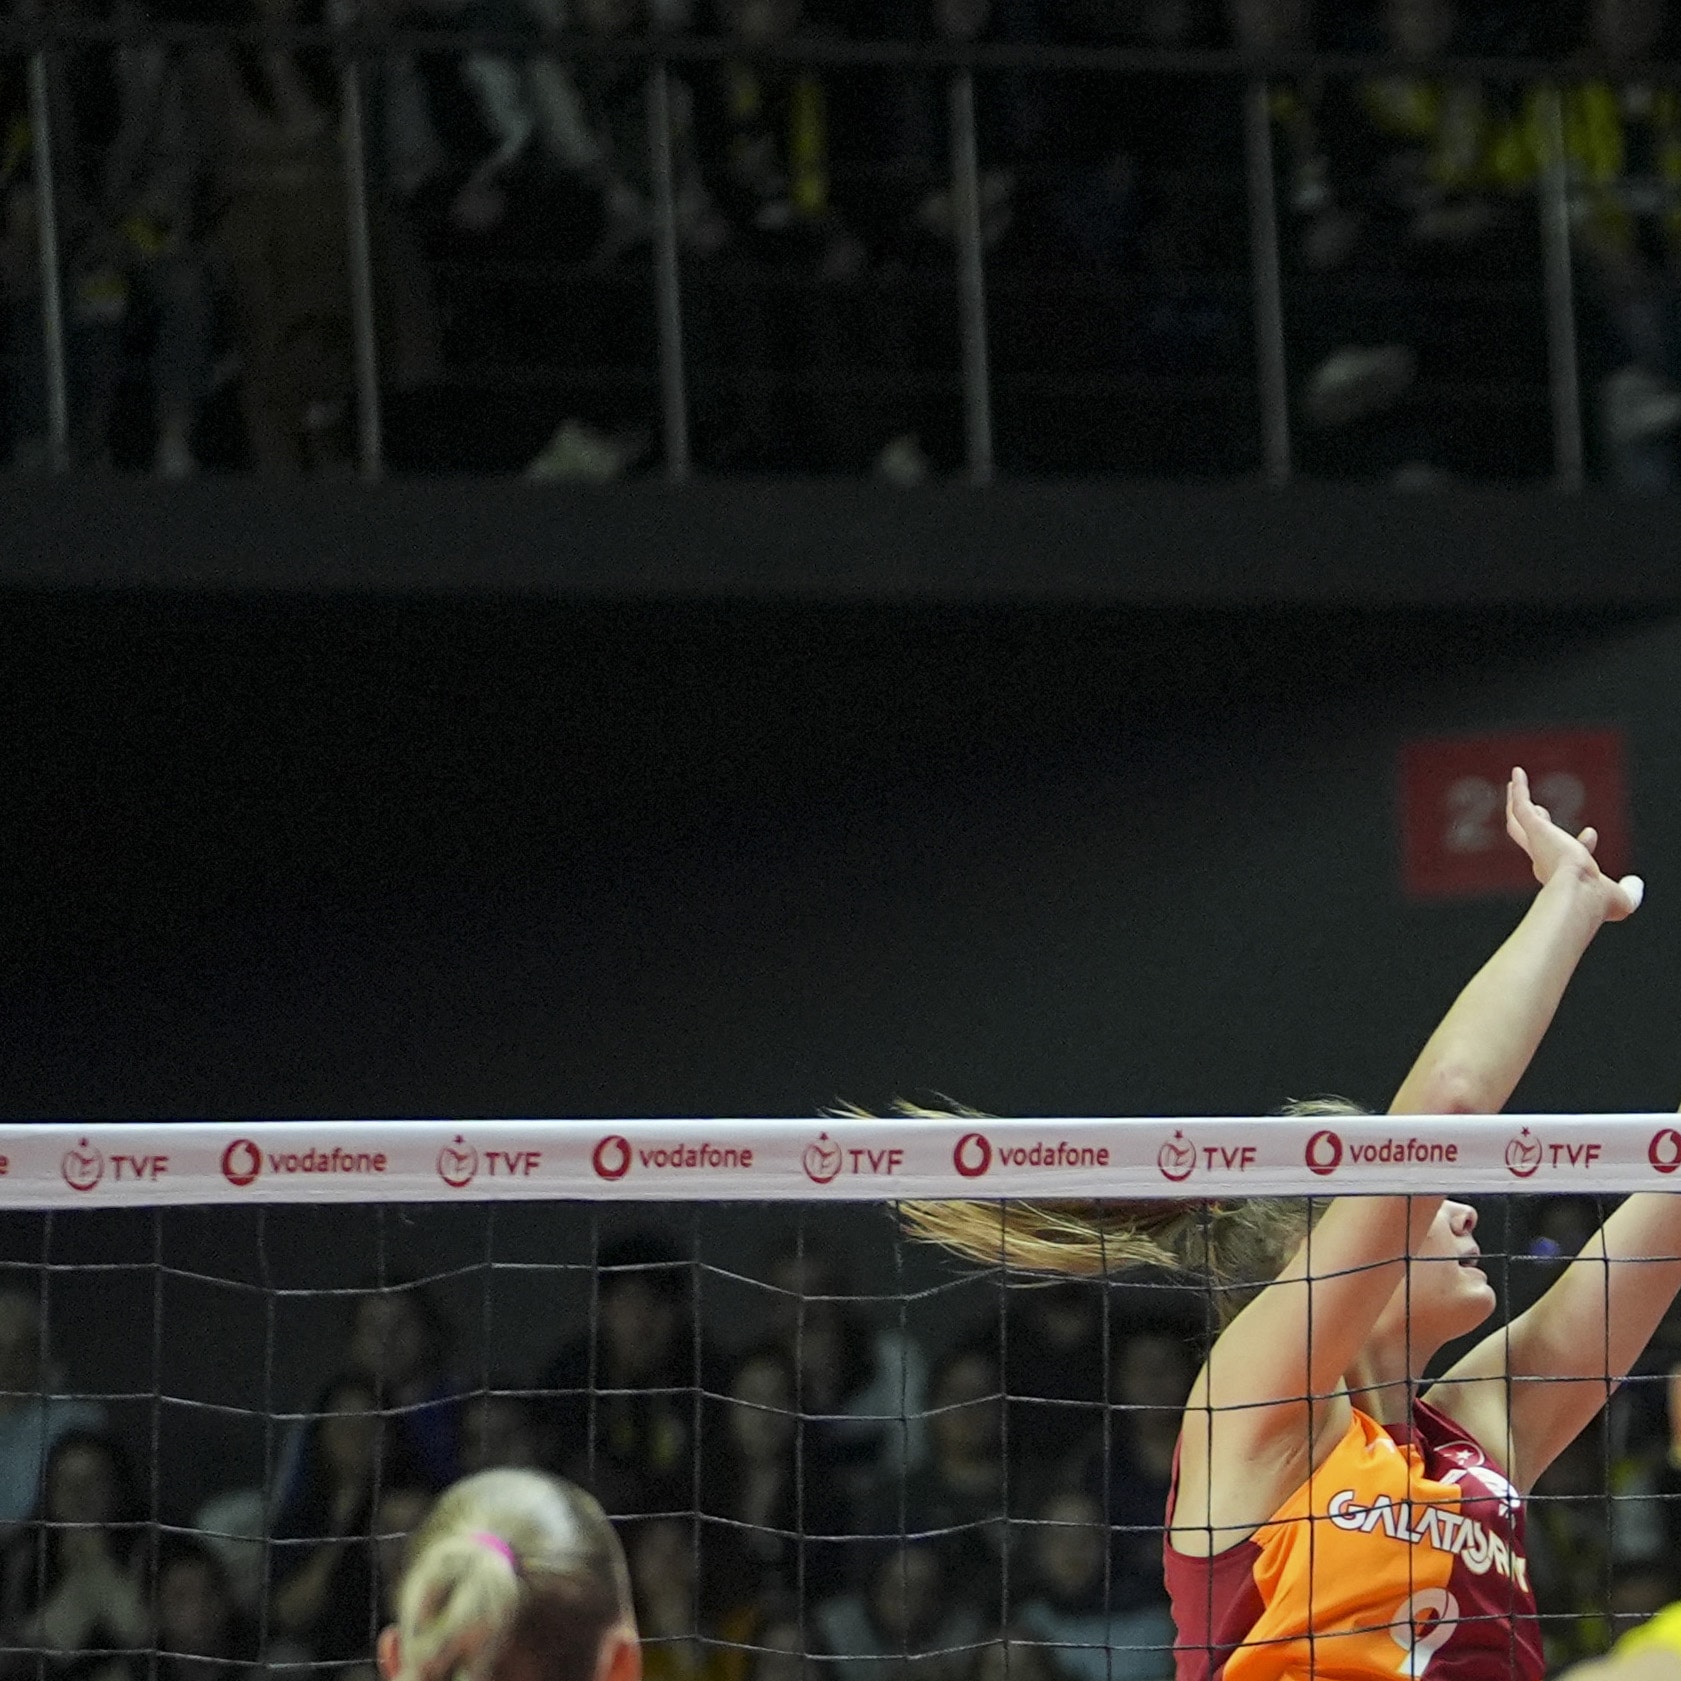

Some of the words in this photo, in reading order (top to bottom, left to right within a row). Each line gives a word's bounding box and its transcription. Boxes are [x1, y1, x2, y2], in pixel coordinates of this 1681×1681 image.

[110, 1153, 169, 1181] TVF
[269, 1144, 388, 1174] vodafone
[485, 1149, 541, 1177] TVF
[638, 1141, 754, 1170] vodafone
[849, 1148, 904, 1176] TVF
[1000, 1141, 1110, 1168] vodafone
[1202, 1145, 1257, 1172] TVF
[1349, 1138, 1459, 1164] vodafone
[1549, 1142, 1602, 1169] TVF
